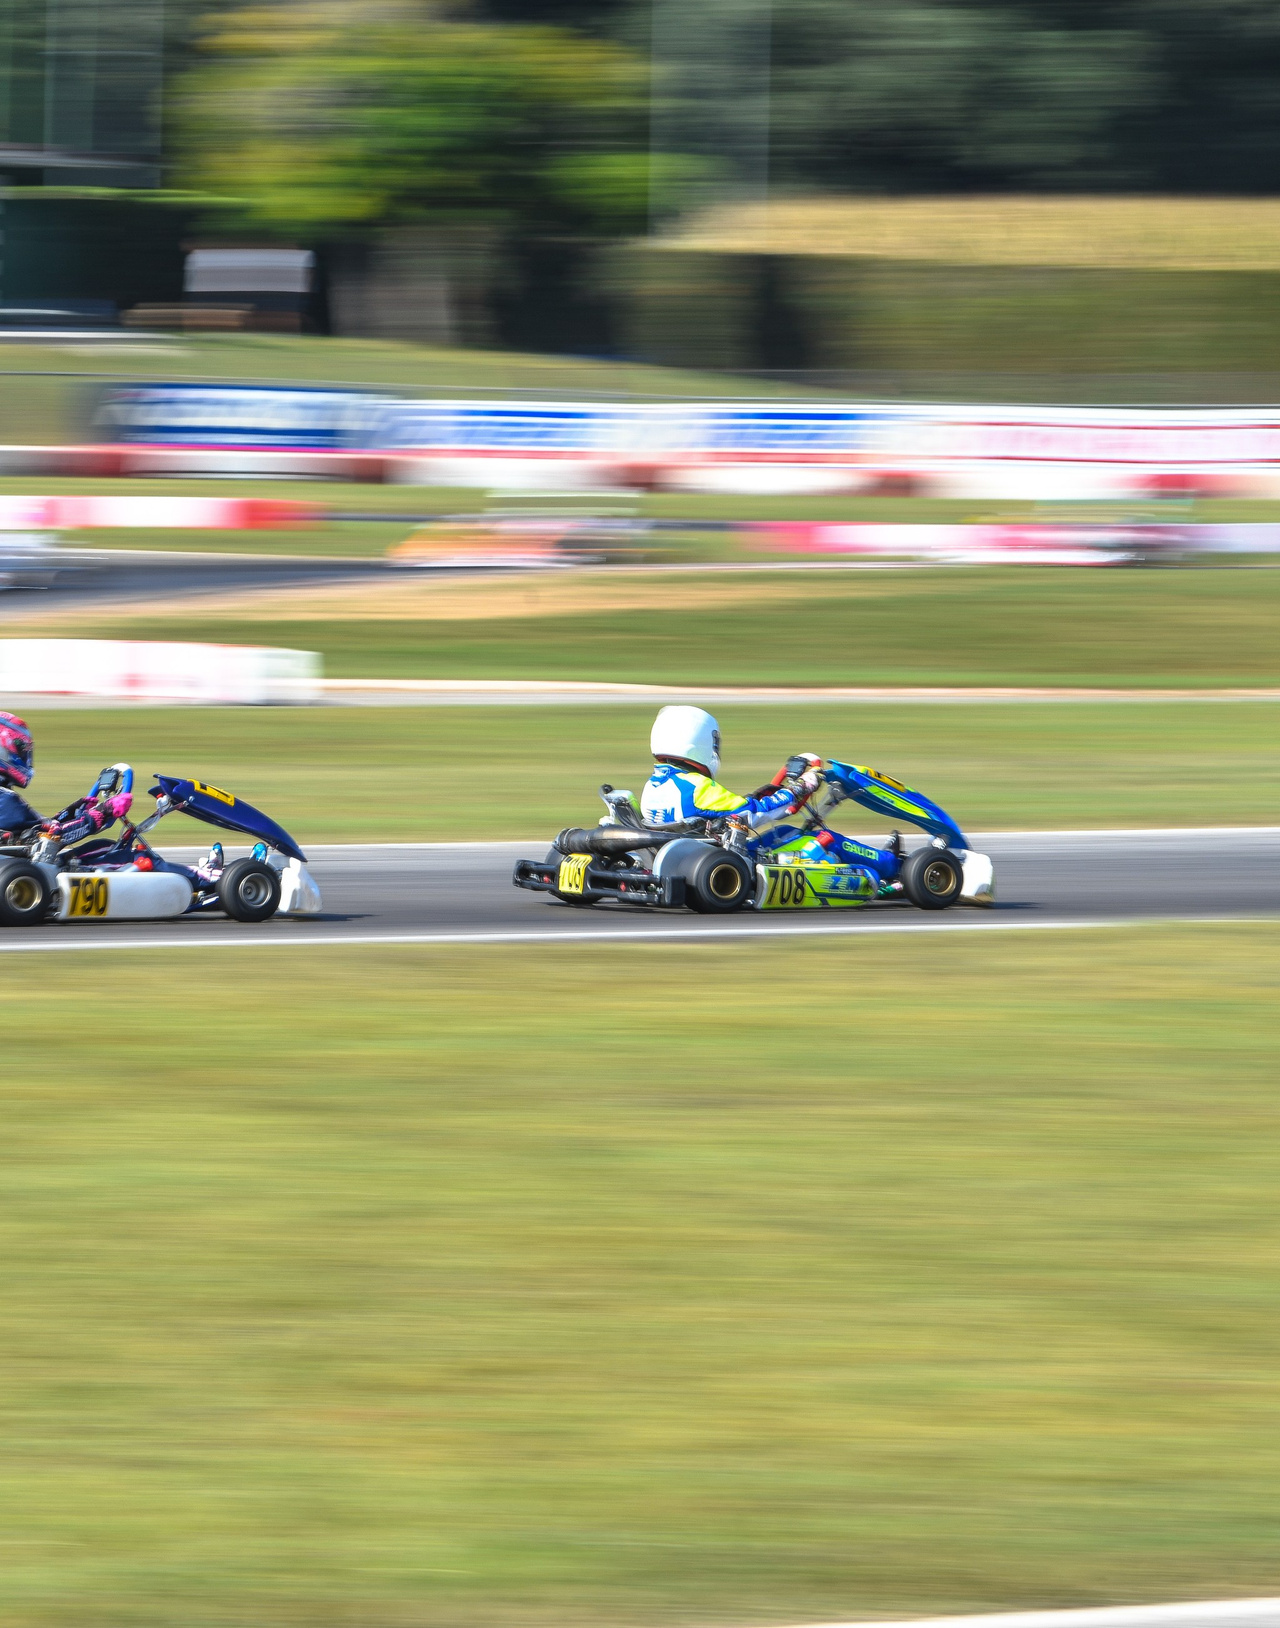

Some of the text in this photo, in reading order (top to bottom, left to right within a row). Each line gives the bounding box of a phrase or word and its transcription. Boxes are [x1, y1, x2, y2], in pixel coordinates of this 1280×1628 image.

[560, 855, 587, 891] 708
[768, 868, 805, 905] 708
[69, 878, 108, 914] 790
